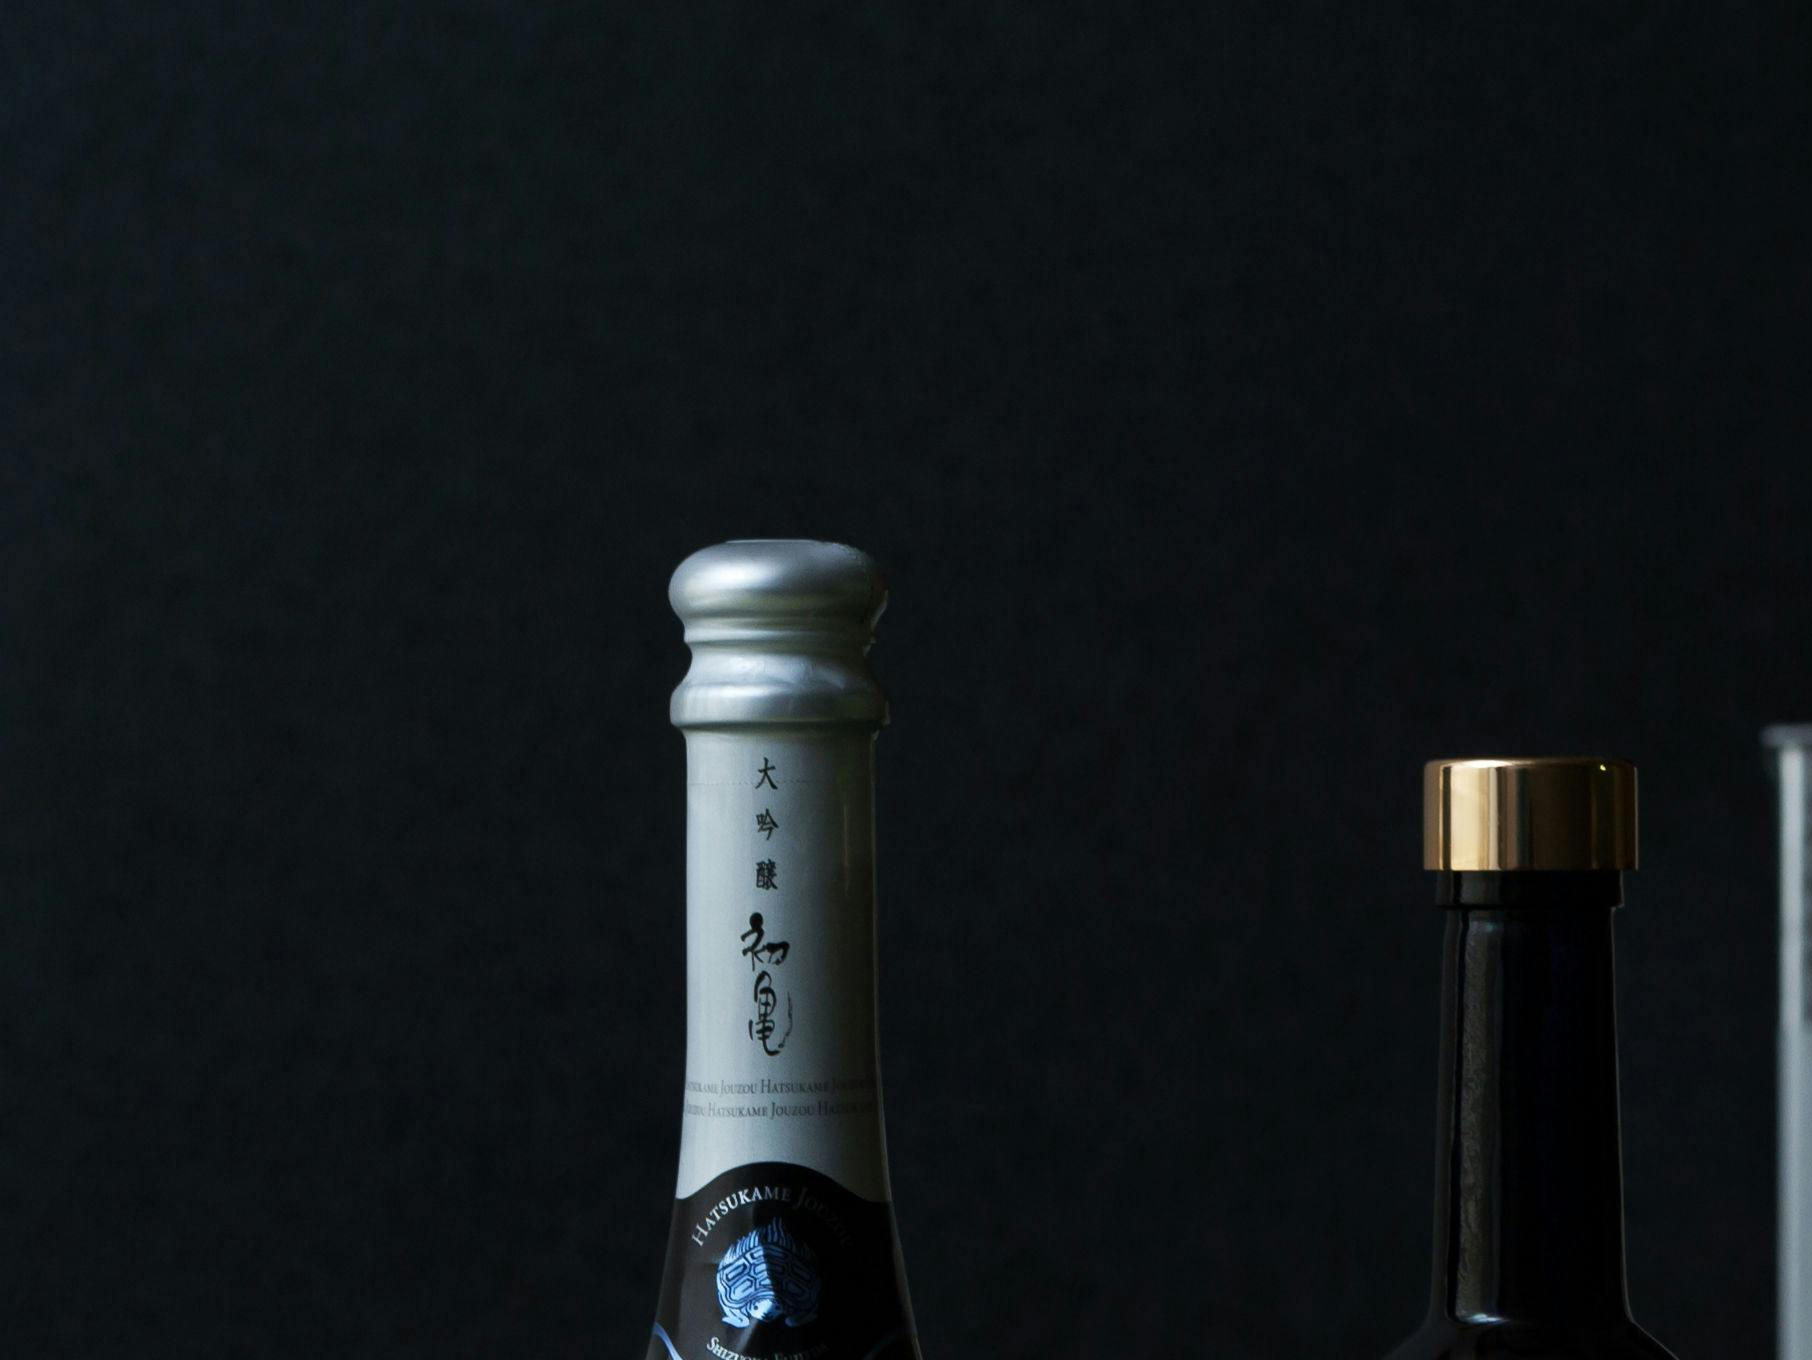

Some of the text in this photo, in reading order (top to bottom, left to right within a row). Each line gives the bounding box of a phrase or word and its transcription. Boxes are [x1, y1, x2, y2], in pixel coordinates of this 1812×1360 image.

[754, 756, 780, 892] 大吟醸
[760, 1077, 829, 1095] HATSUKAME
[770, 1101, 815, 1121] JOUZOU
[690, 1185, 791, 1248] HATSUKAME
